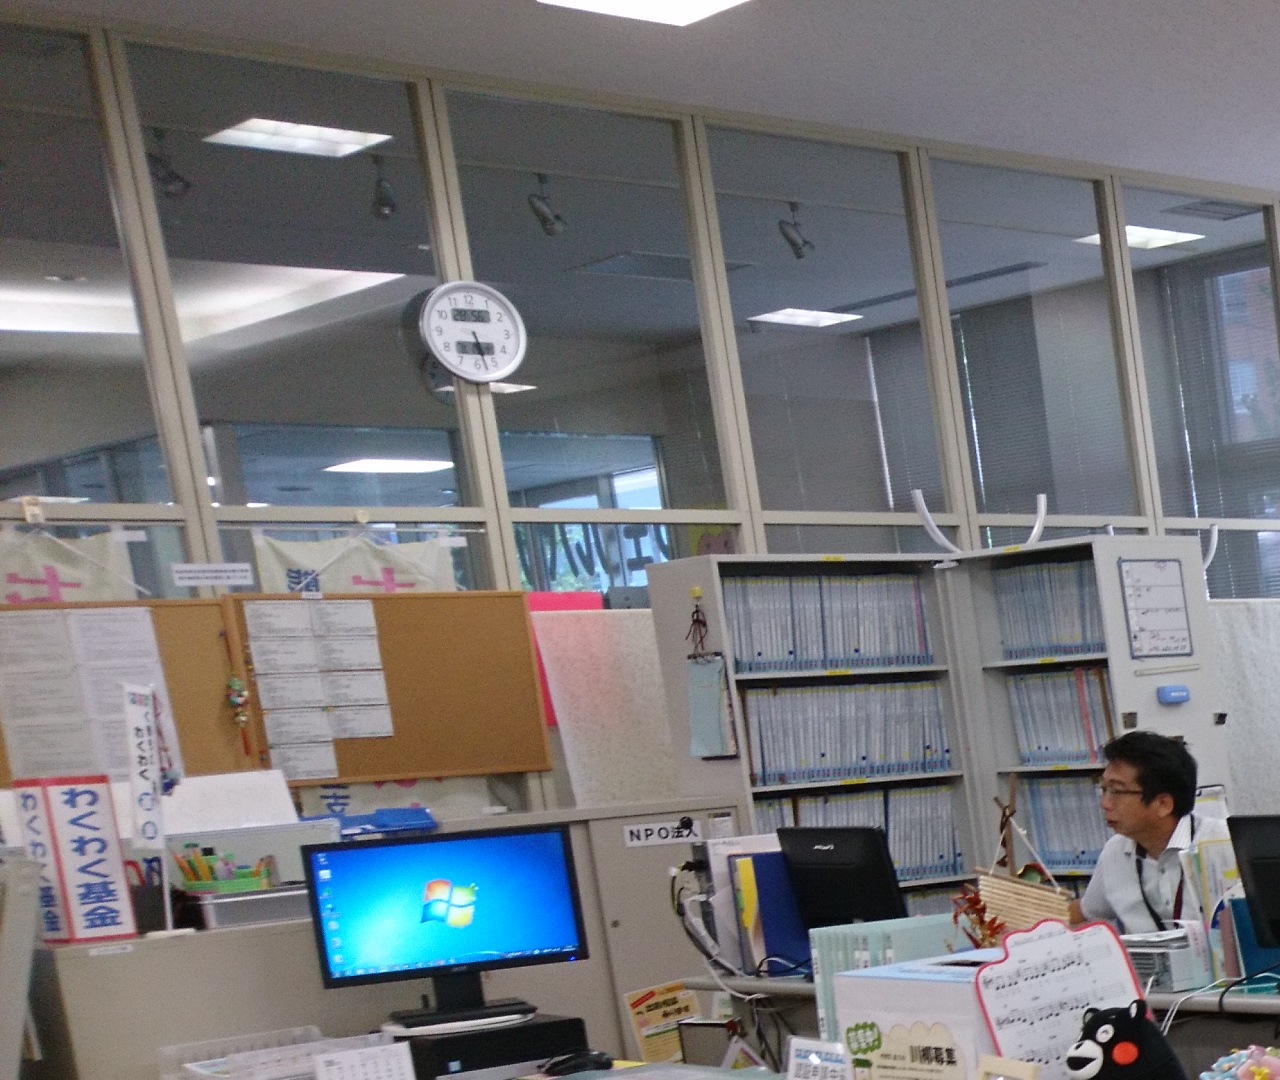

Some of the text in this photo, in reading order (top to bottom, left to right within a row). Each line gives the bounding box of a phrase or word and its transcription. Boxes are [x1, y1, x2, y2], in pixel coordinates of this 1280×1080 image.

[60, 787, 123, 930] わくわく基金
[629, 826, 699, 843] NPO法人
